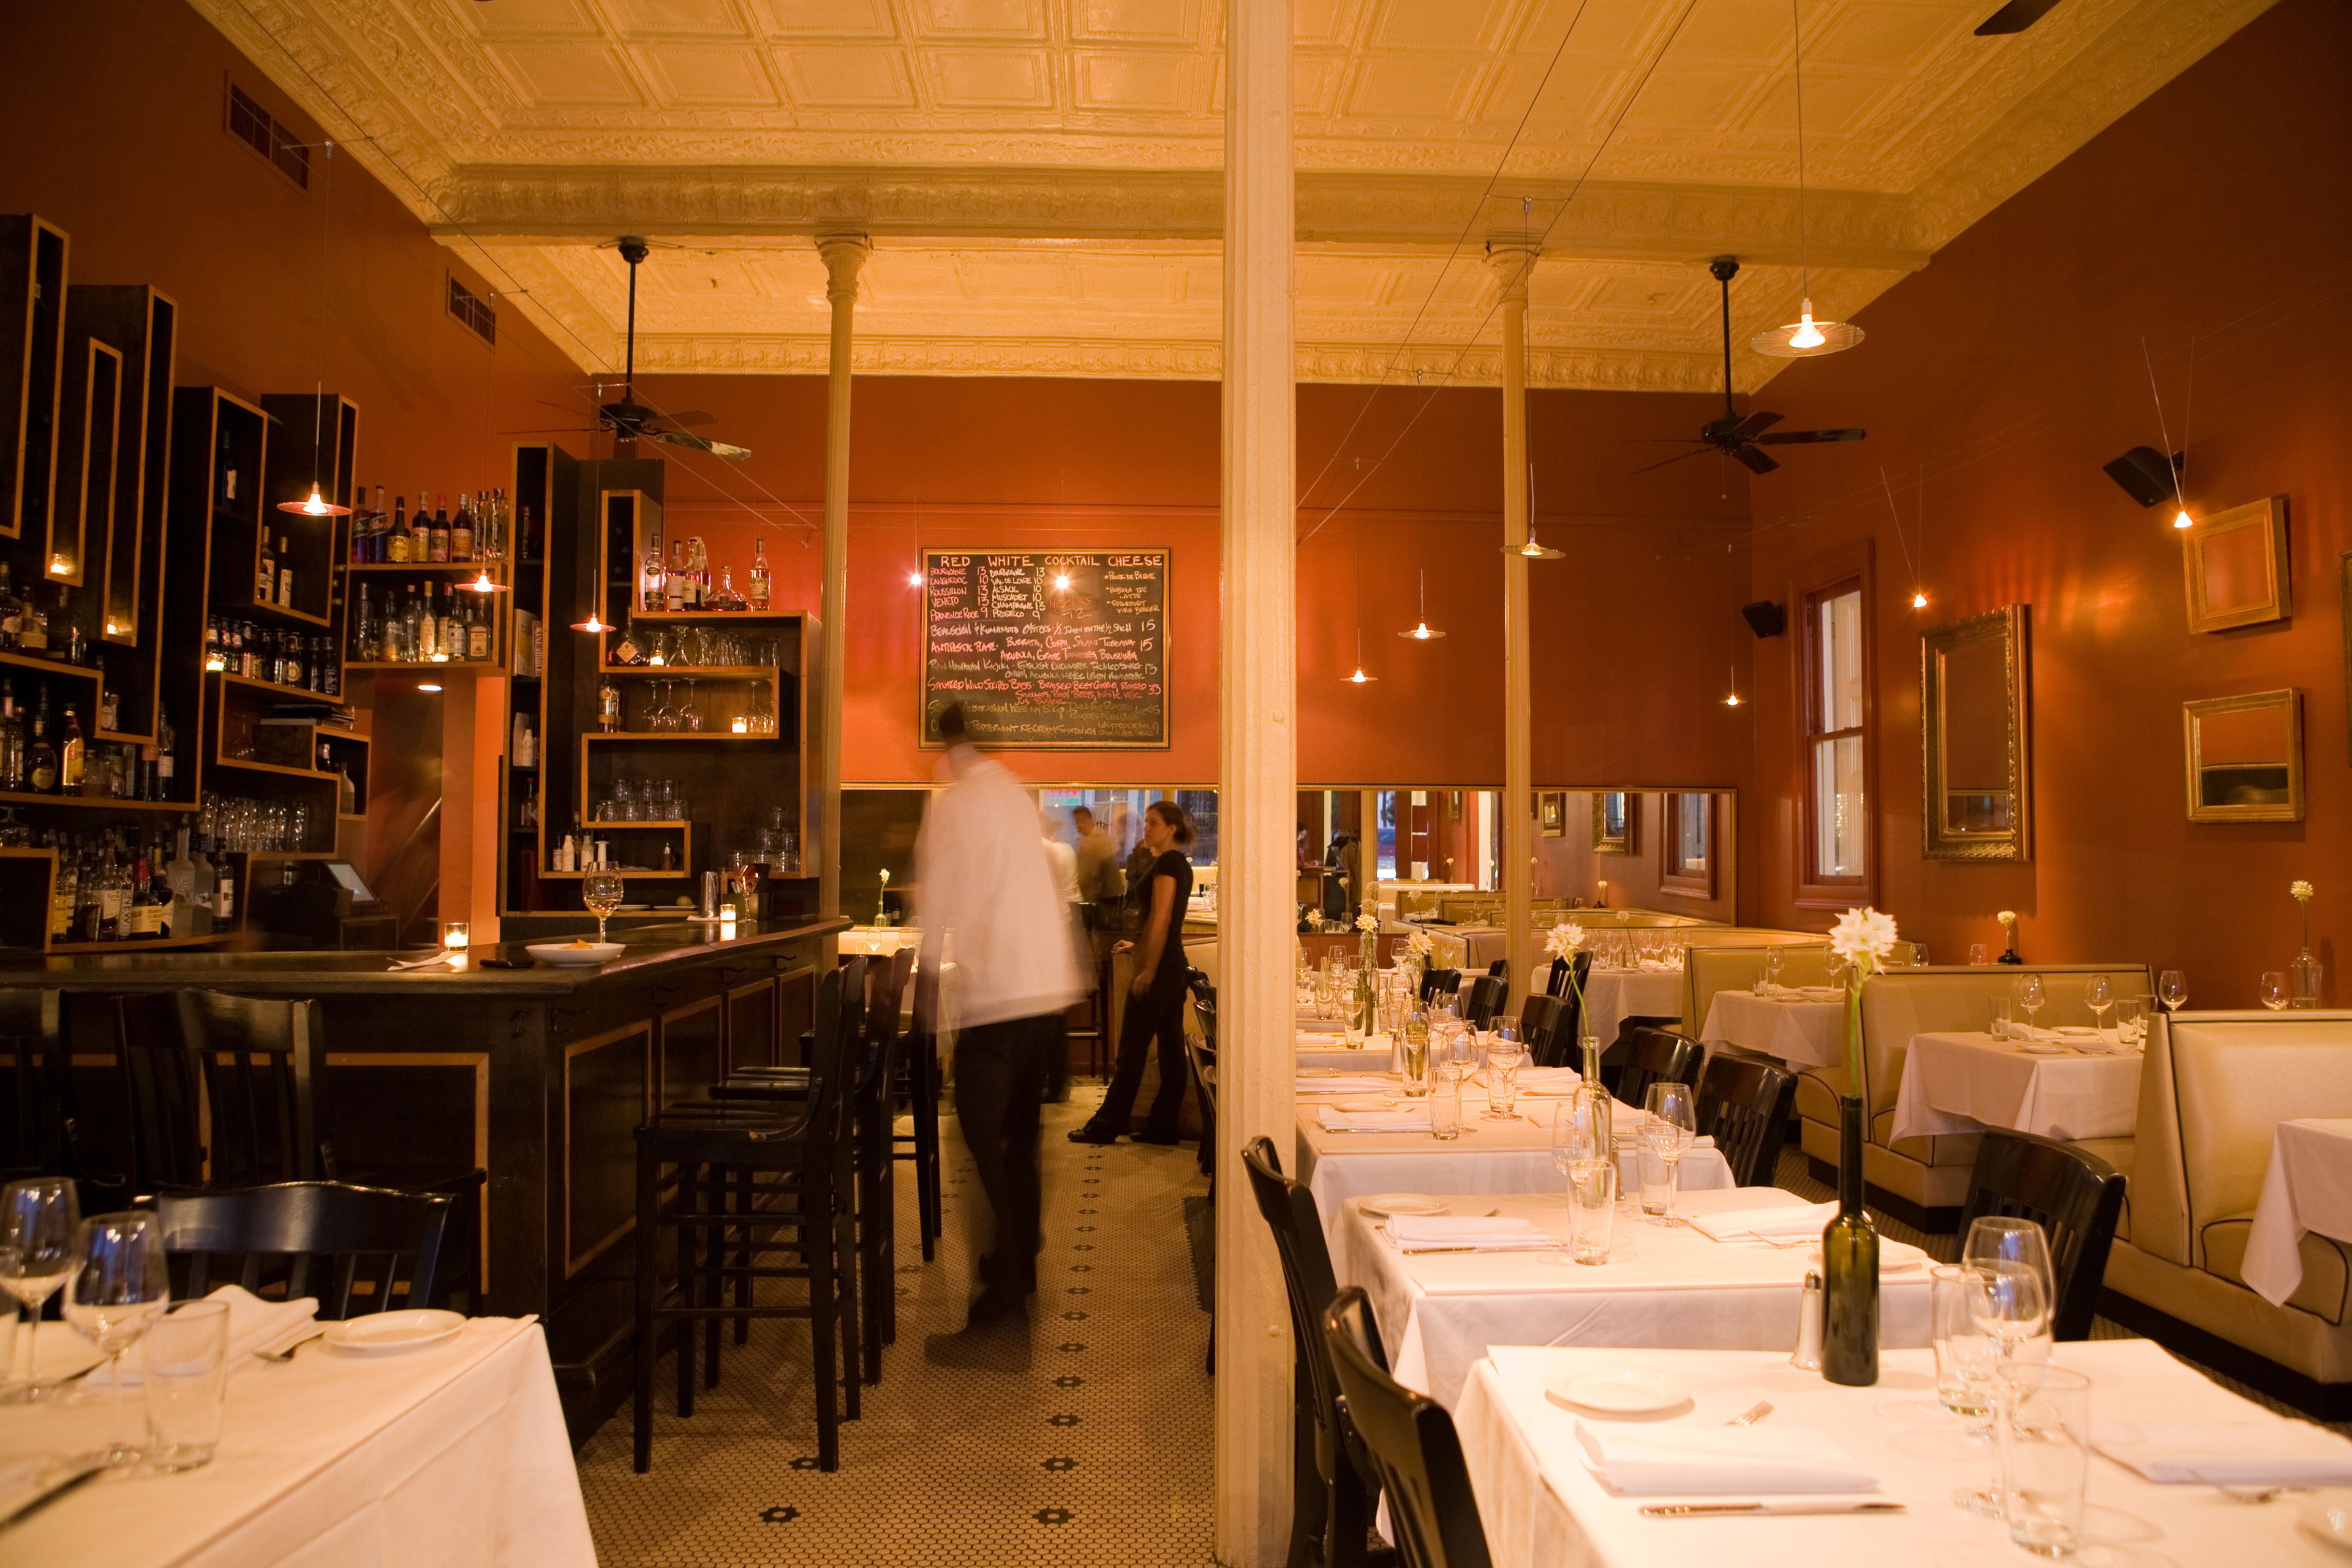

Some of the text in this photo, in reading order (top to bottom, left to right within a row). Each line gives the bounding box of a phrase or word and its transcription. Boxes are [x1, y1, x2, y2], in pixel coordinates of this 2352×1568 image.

[941, 556, 970, 567] RED
[987, 556, 1035, 567] WHITE
[1045, 556, 1100, 566] COCKTAIL
[1108, 556, 1163, 567] CHEESE
[930, 566, 987, 576] BOURGOGNE 13
[1036, 567, 1045, 577] 13
[930, 575, 989, 585] LANGUEDOC 10
[929, 585, 988, 597] ROUSSILLON 13
[992, 584, 1042, 594] ALSACE 10
[931, 596, 989, 608] VENETO 13
[992, 592, 1042, 602] MUSCADET 10
[991, 601, 1033, 611] CHAMPAGNE
[1035, 601, 1046, 611] 13
[981, 606, 988, 618] 9
[992, 608, 1041, 620] PROSECCO 9
[1142, 619, 1156, 631] 15
[1140, 637, 1153, 652] 15
